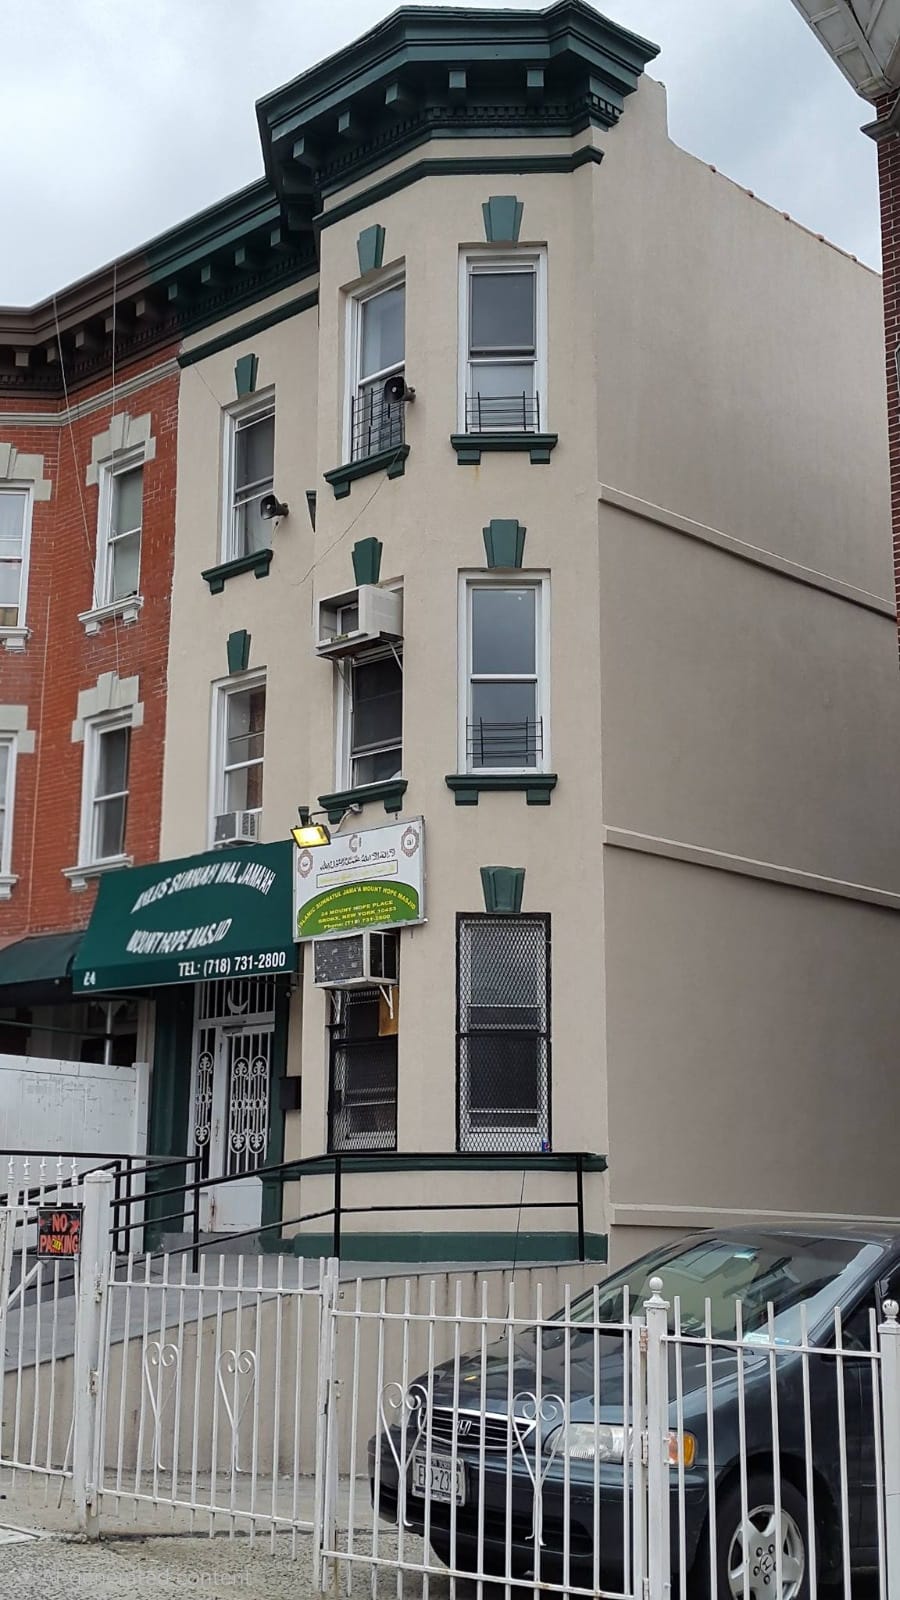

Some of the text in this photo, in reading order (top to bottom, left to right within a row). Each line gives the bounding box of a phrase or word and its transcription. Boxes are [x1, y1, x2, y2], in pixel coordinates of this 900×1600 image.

[214, 861, 241, 884] WAL
[362, 885, 382, 893] MOUNT
[382, 887, 397, 897] HOPE
[372, 899, 394, 908] PLACE
[357, 910, 376, 918] YORK
[178, 951, 286, 977] TEL: (718) 731-2800
[52, 1212, 68, 1232] NO
